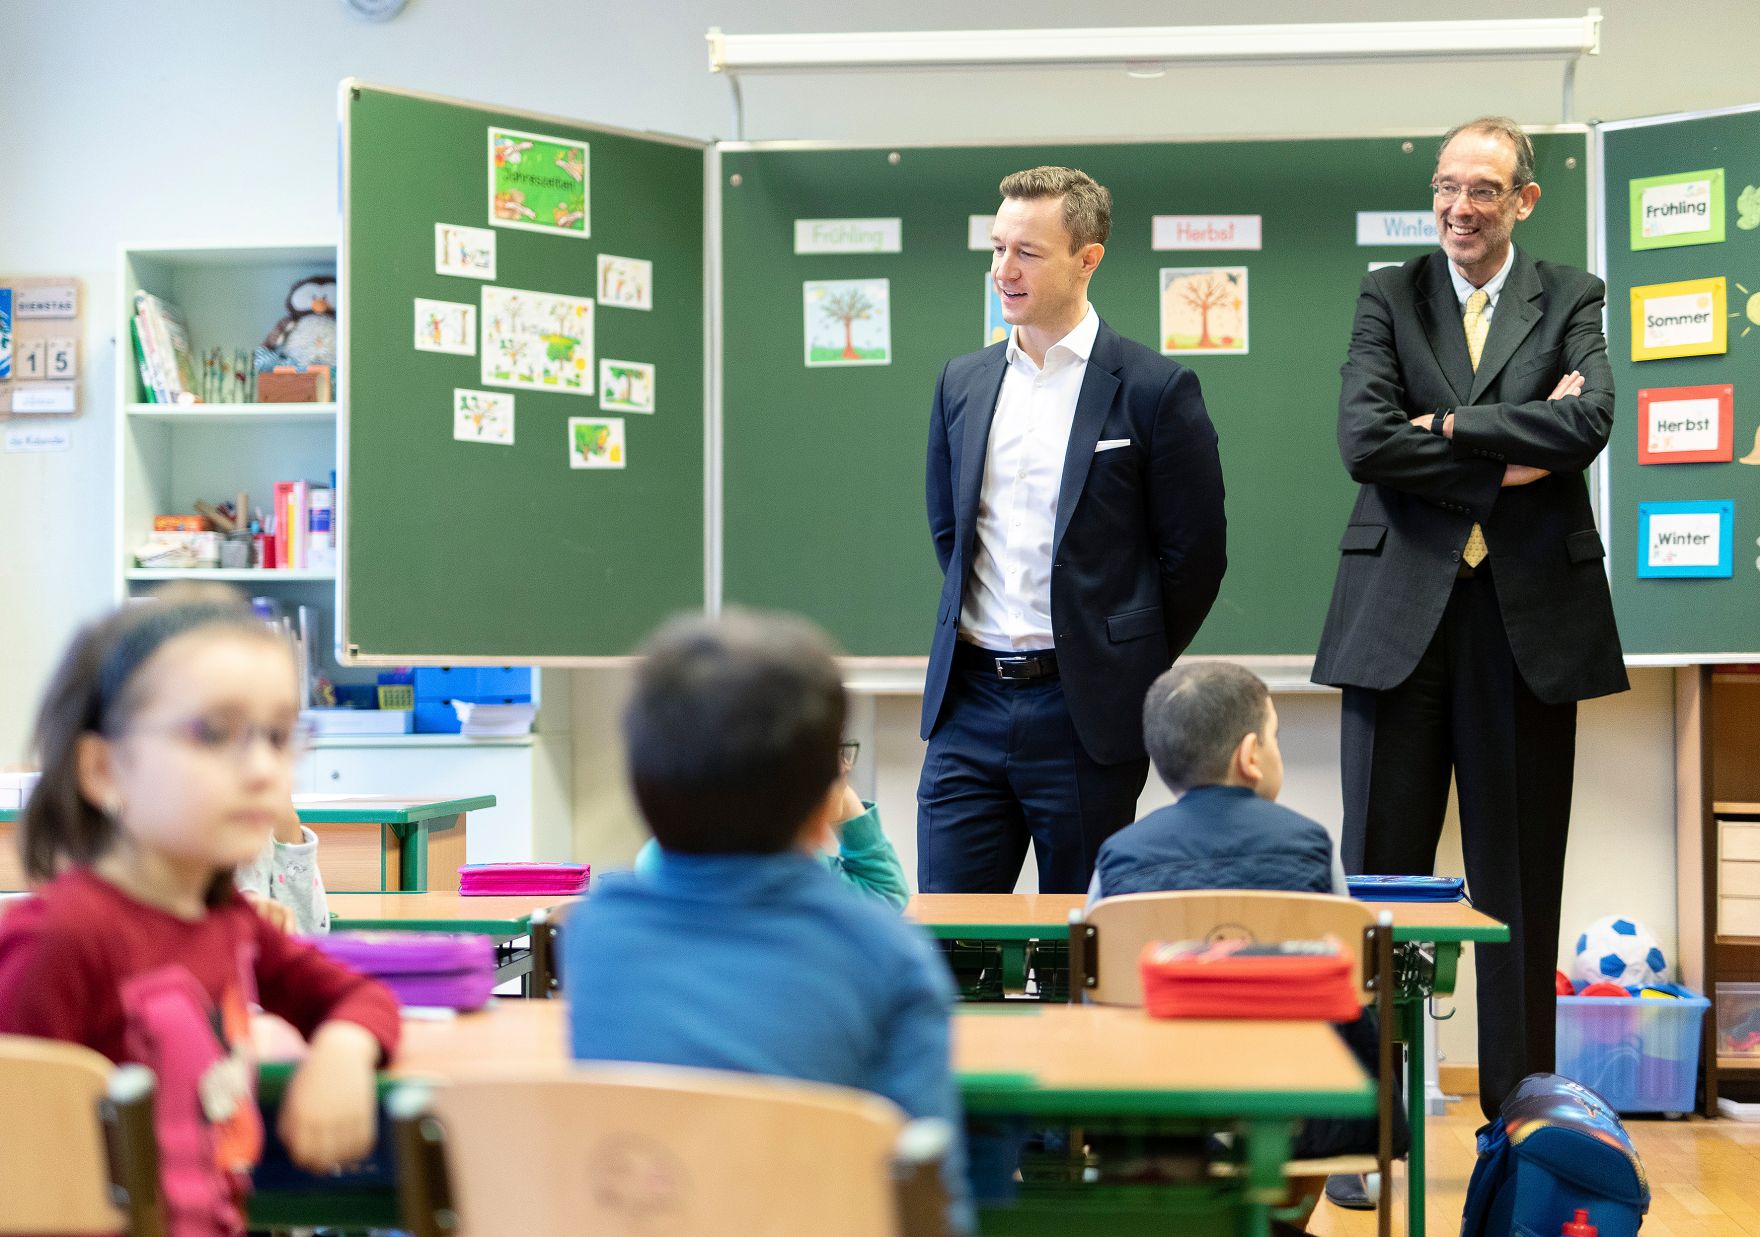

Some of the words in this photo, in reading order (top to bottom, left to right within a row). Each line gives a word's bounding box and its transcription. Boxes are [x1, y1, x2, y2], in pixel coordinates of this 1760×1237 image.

[1646, 201, 1706, 218] Frühling
[812, 223, 884, 250] Frühling
[1176, 222, 1234, 242] Herbst
[17, 301, 73, 312] DIENSTAG
[1647, 312, 1710, 328] Sommer
[1657, 418, 1710, 433] Herbst
[1658, 532, 1710, 545] Winter
